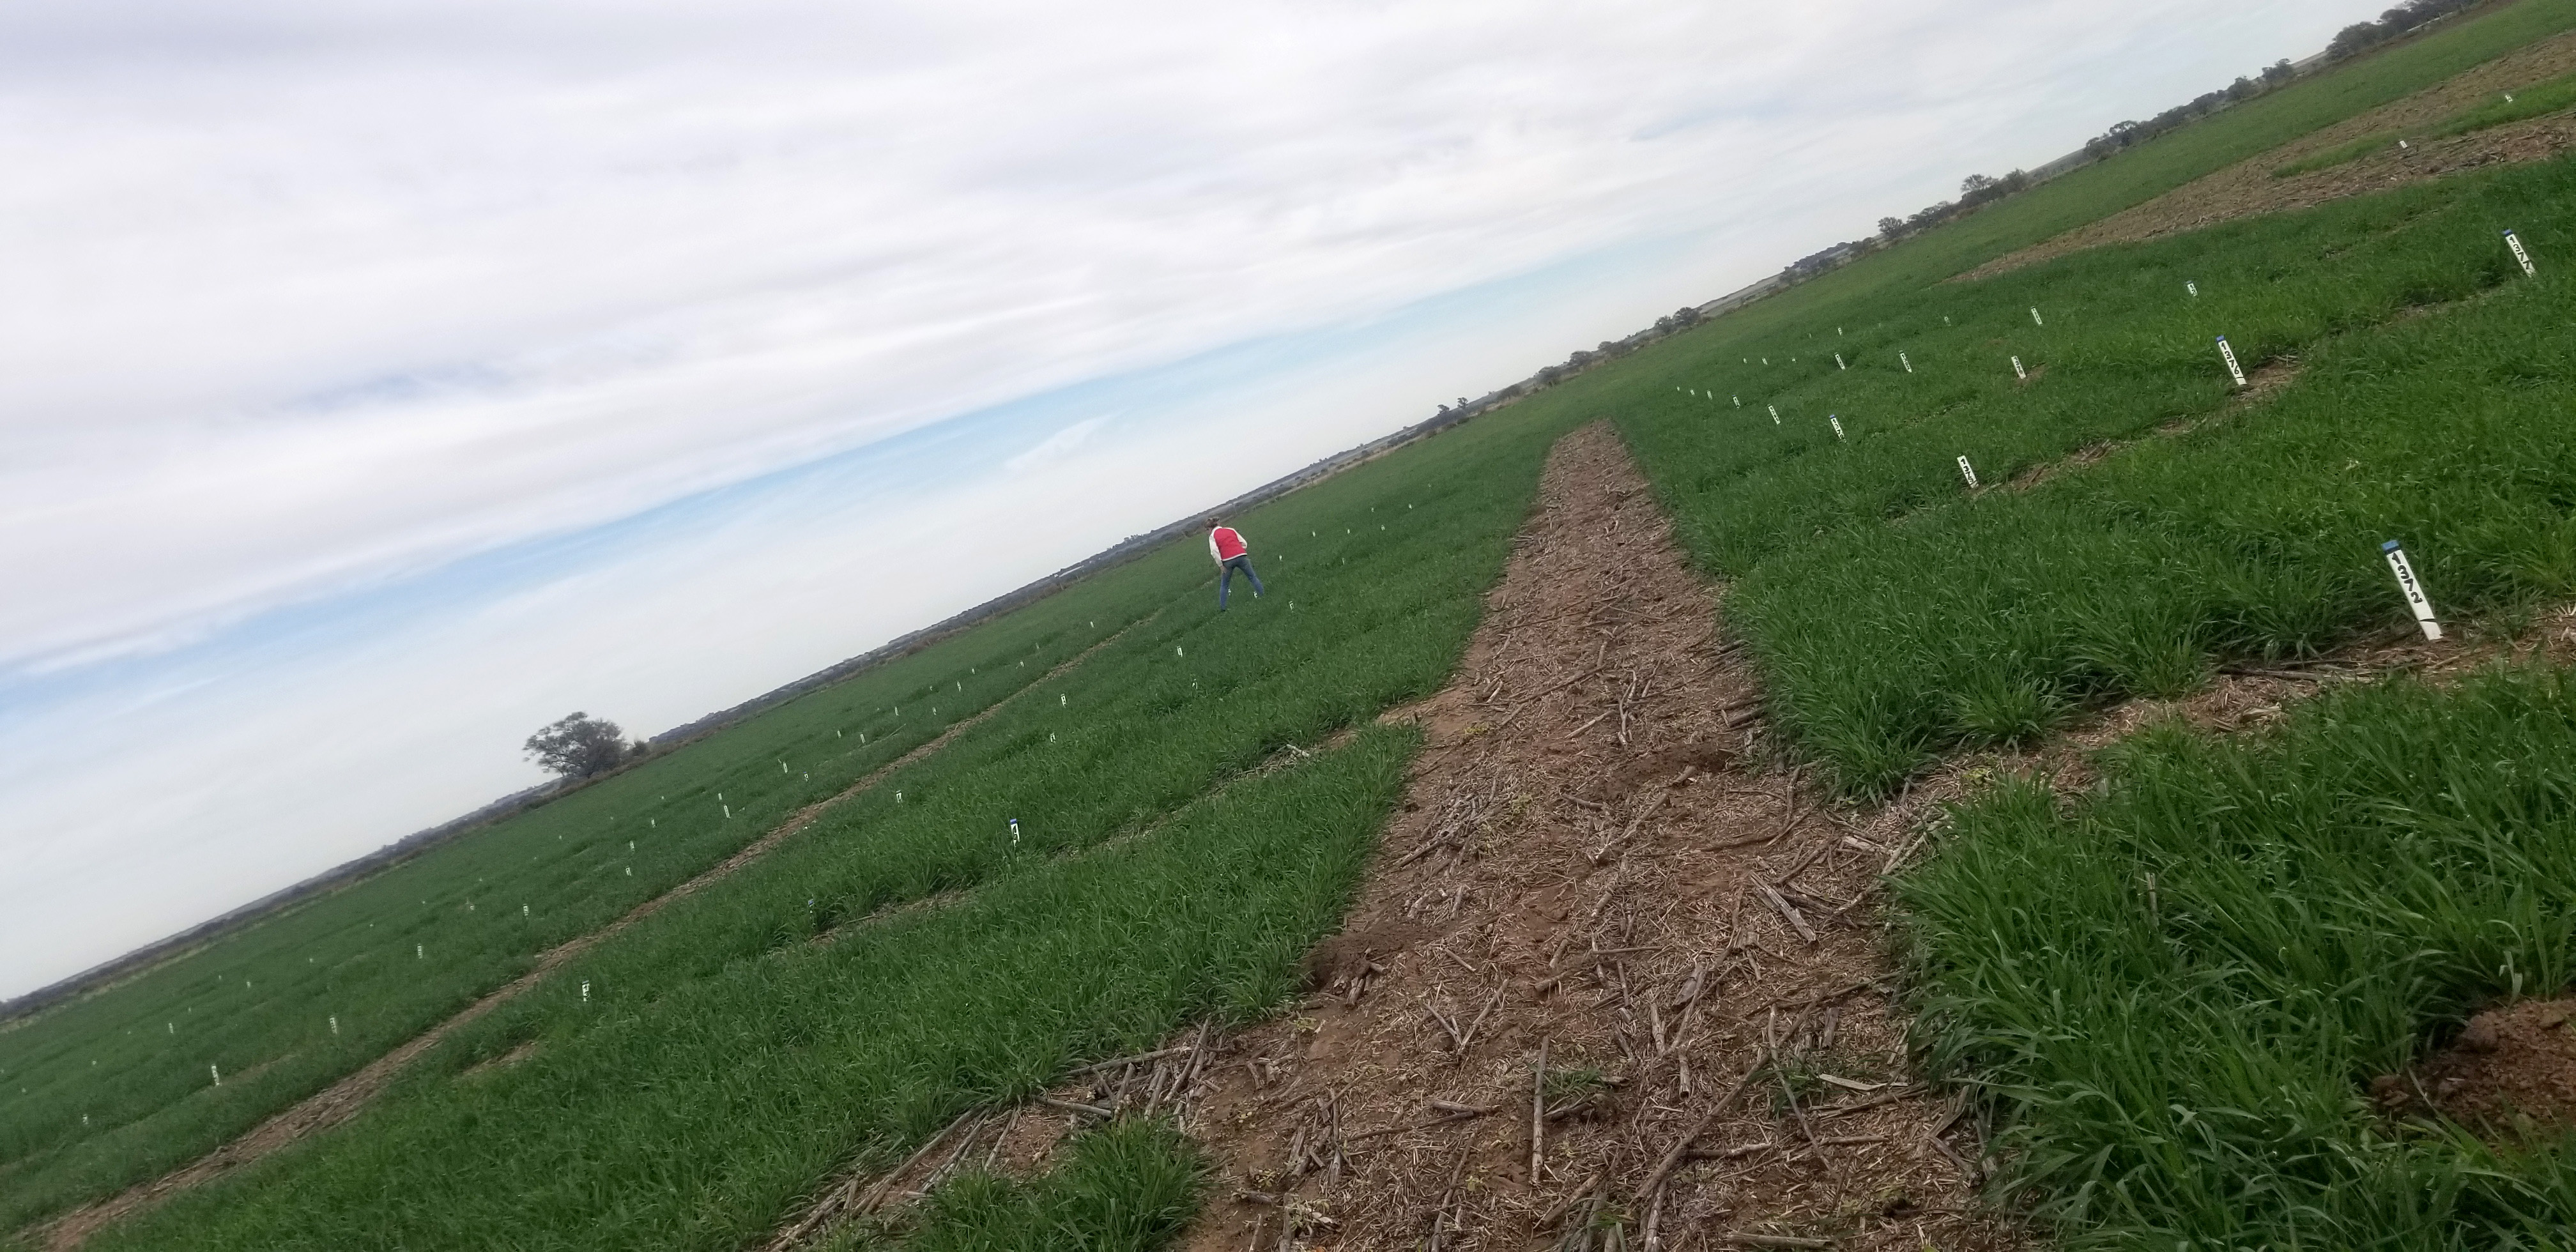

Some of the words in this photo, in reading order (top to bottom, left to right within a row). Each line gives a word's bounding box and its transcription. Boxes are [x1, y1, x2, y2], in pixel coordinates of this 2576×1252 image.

[2509, 236, 2532, 270] 1377
[2221, 342, 2240, 375] 1376
[1960, 458, 1974, 483] 1375
[2391, 552, 2423, 604] 1372
